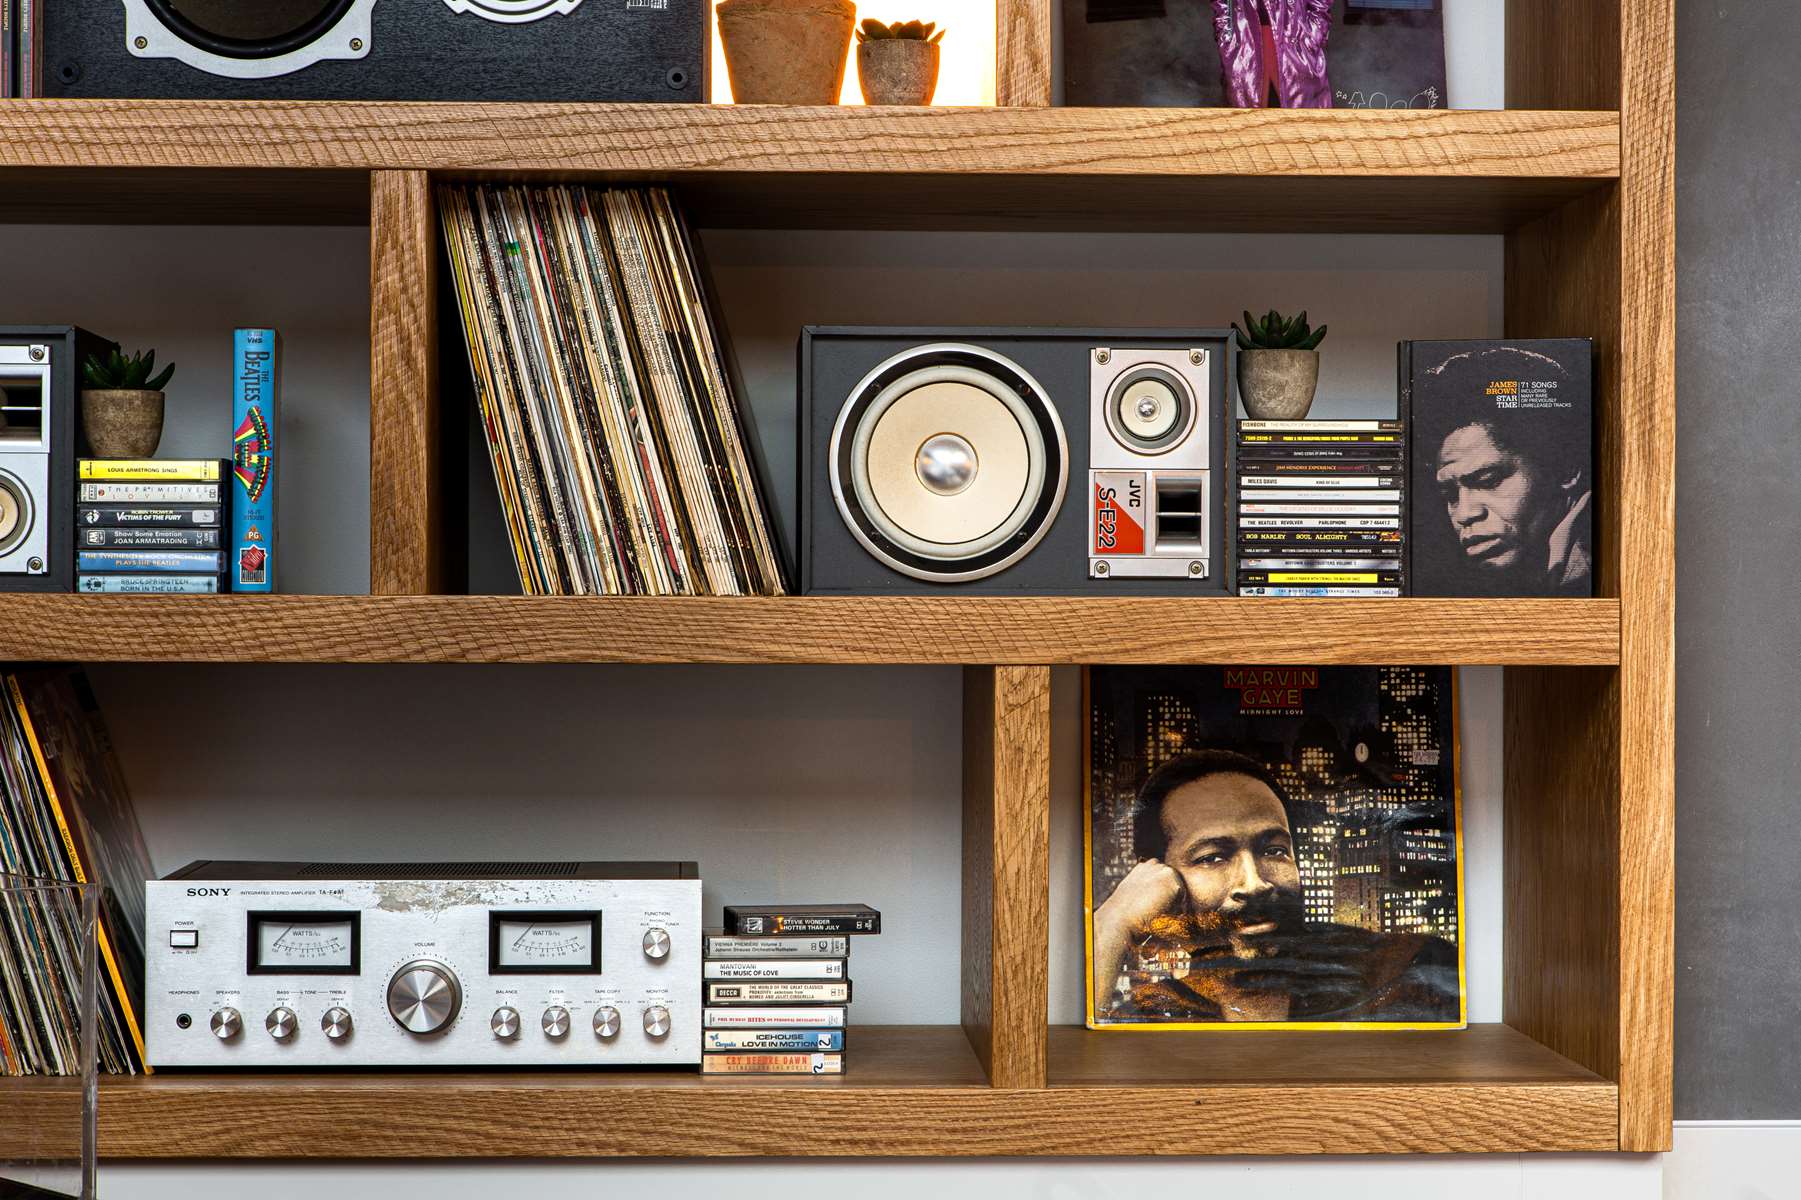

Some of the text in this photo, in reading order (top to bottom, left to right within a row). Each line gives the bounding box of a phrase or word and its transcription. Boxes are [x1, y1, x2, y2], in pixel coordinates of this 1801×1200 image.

[247, 336, 263, 344] VHS
[240, 351, 270, 402] BEATLES
[262, 369, 270, 383] THE
[1128, 479, 1141, 508] JVC
[116, 512, 142, 522] VICTIMS
[1098, 487, 1117, 549] S-E22
[248, 531, 260, 539] PG
[1227, 670, 1316, 686] MARVIN
[1243, 690, 1299, 704] GAYE
[186, 888, 232, 896] SONY
[726, 1056, 742, 1064] CRY
[784, 1056, 808, 1064] DAWN
